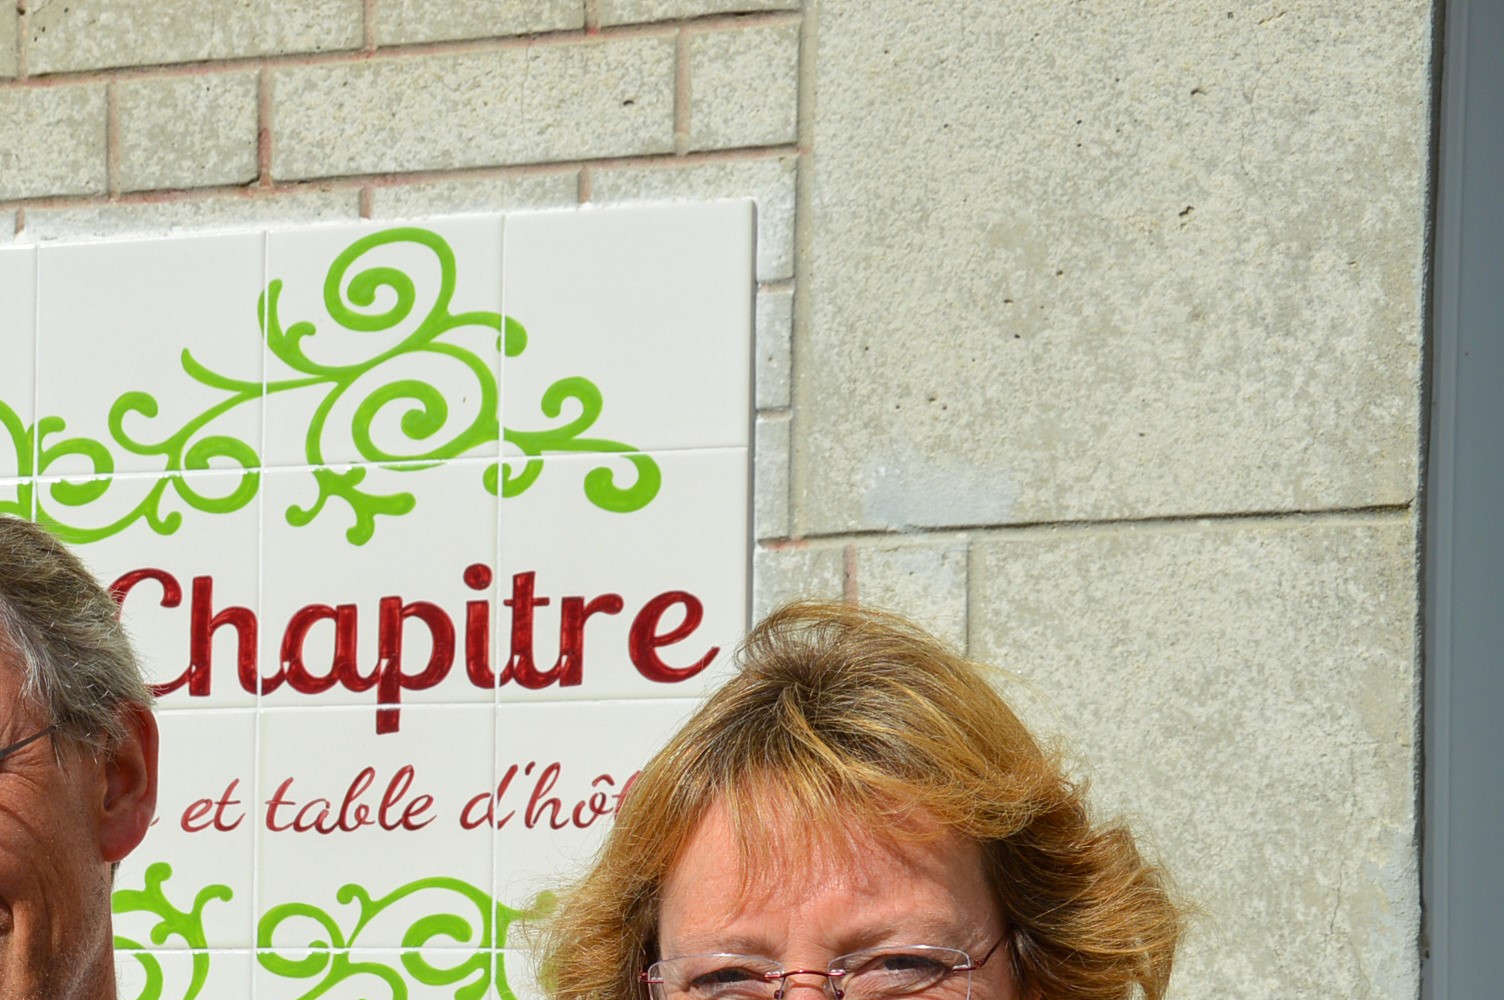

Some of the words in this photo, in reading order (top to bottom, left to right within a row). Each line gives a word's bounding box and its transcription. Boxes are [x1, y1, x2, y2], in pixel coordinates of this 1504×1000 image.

[107, 563, 720, 735] Chapitre
[180, 777, 246, 833] et
[264, 764, 437, 835] table
